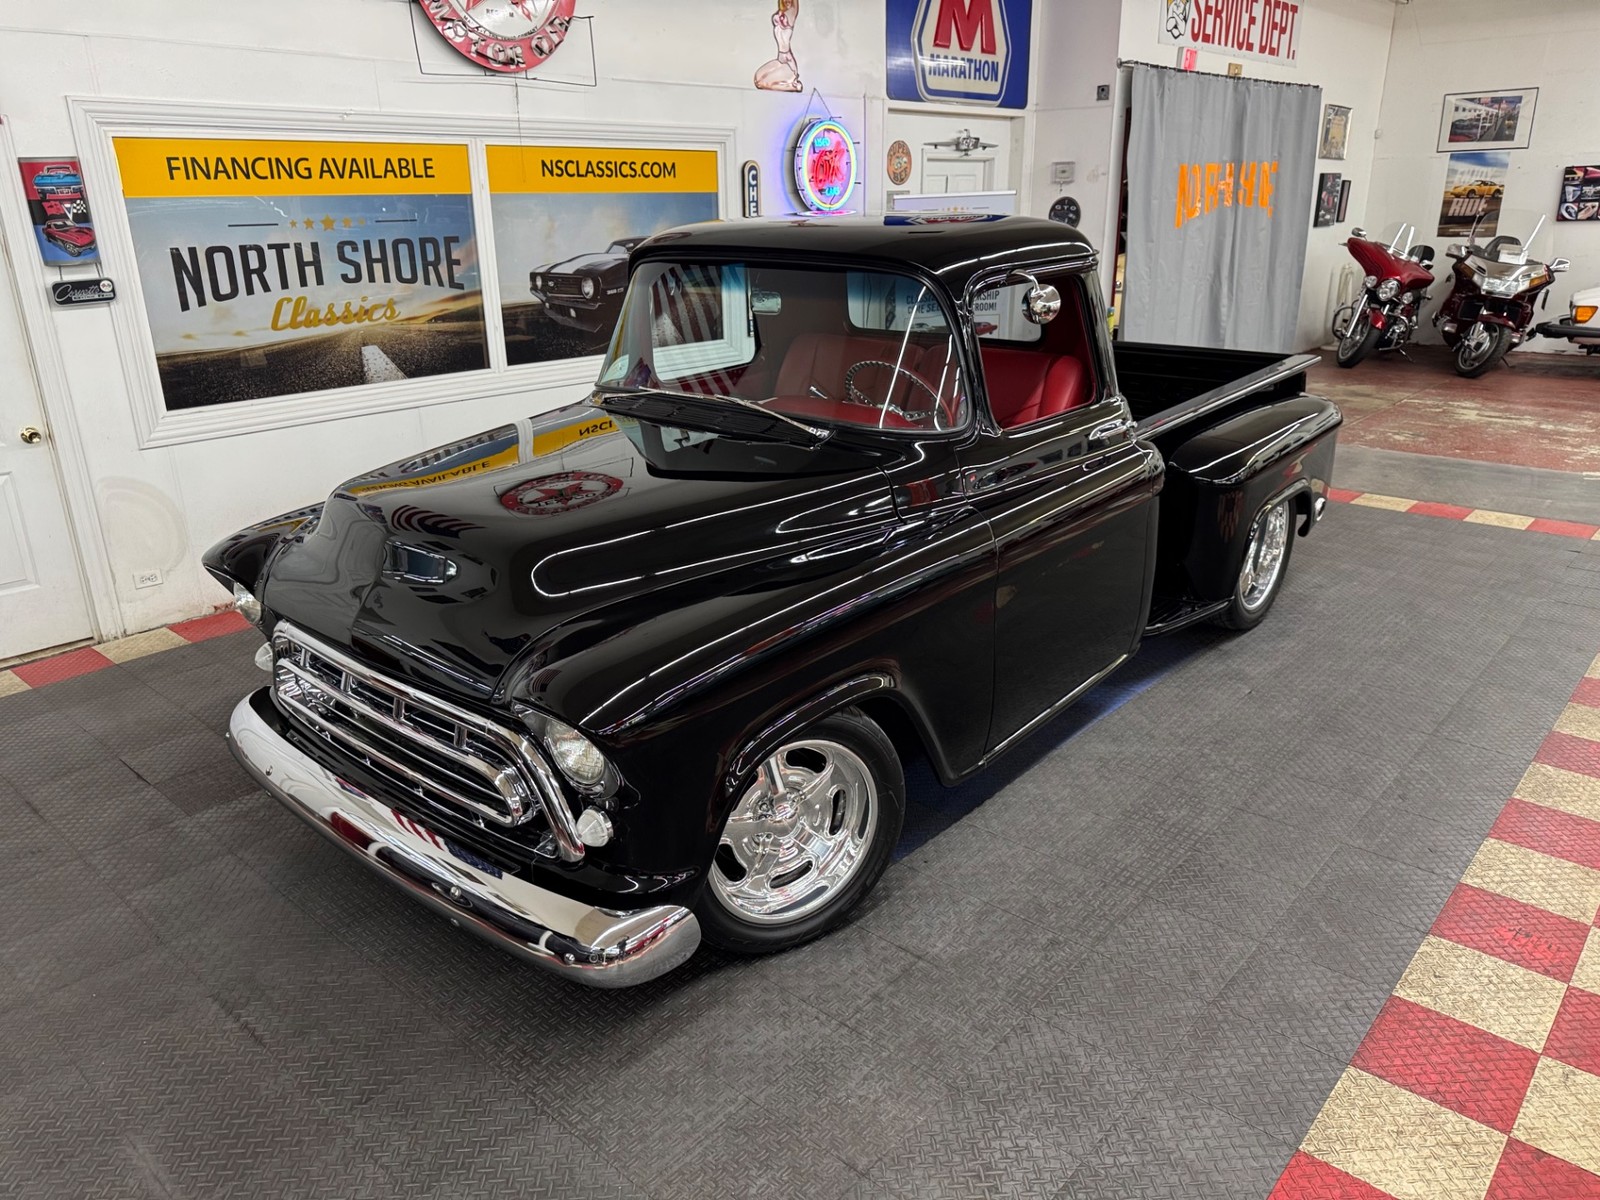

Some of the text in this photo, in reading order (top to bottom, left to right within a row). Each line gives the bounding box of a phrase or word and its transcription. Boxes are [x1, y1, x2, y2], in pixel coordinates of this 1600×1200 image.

[1190, 0, 1298, 60] SERVICE DEPT.
[928, 53, 999, 82] MARATHON
[165, 156, 435, 181] FINANCING AVAILABLE
[541, 159, 677, 179] NSCLASSICS.COM
[1448, 197, 1488, 216] RIDE
[170, 235, 466, 311] NORTH SHORE
[55, 284, 103, 302] Corvette
[271, 295, 402, 331] Classics
